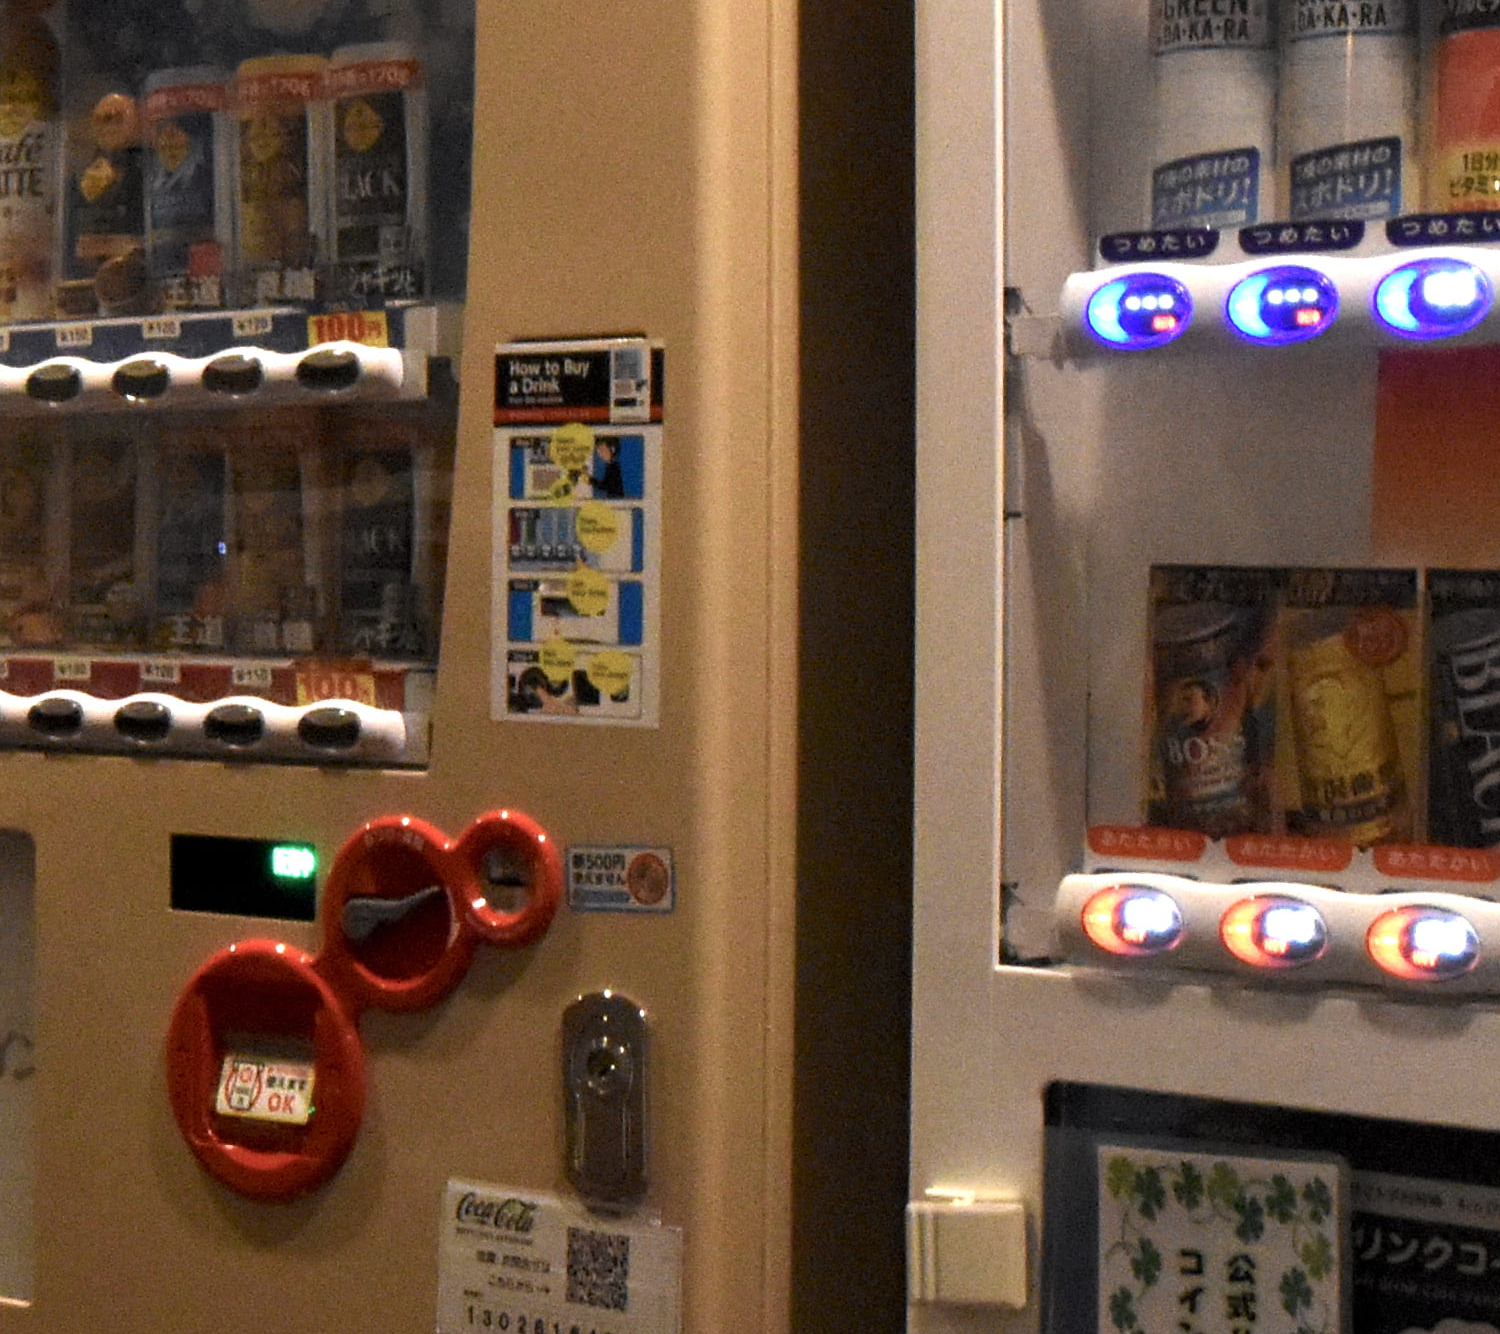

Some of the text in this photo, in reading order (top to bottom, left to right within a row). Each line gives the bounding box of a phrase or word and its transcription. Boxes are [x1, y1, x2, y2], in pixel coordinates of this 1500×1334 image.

[1110, 231, 1205, 255] つめたい
[1251, 221, 1353, 246] つめたい
[508, 357, 590, 379] How to Buy
[521, 376, 561, 395] Drink
[1386, 850, 1492, 876] あたたかい
[267, 1092, 296, 1114] OK
[456, 1191, 539, 1236] Coca-Cola
